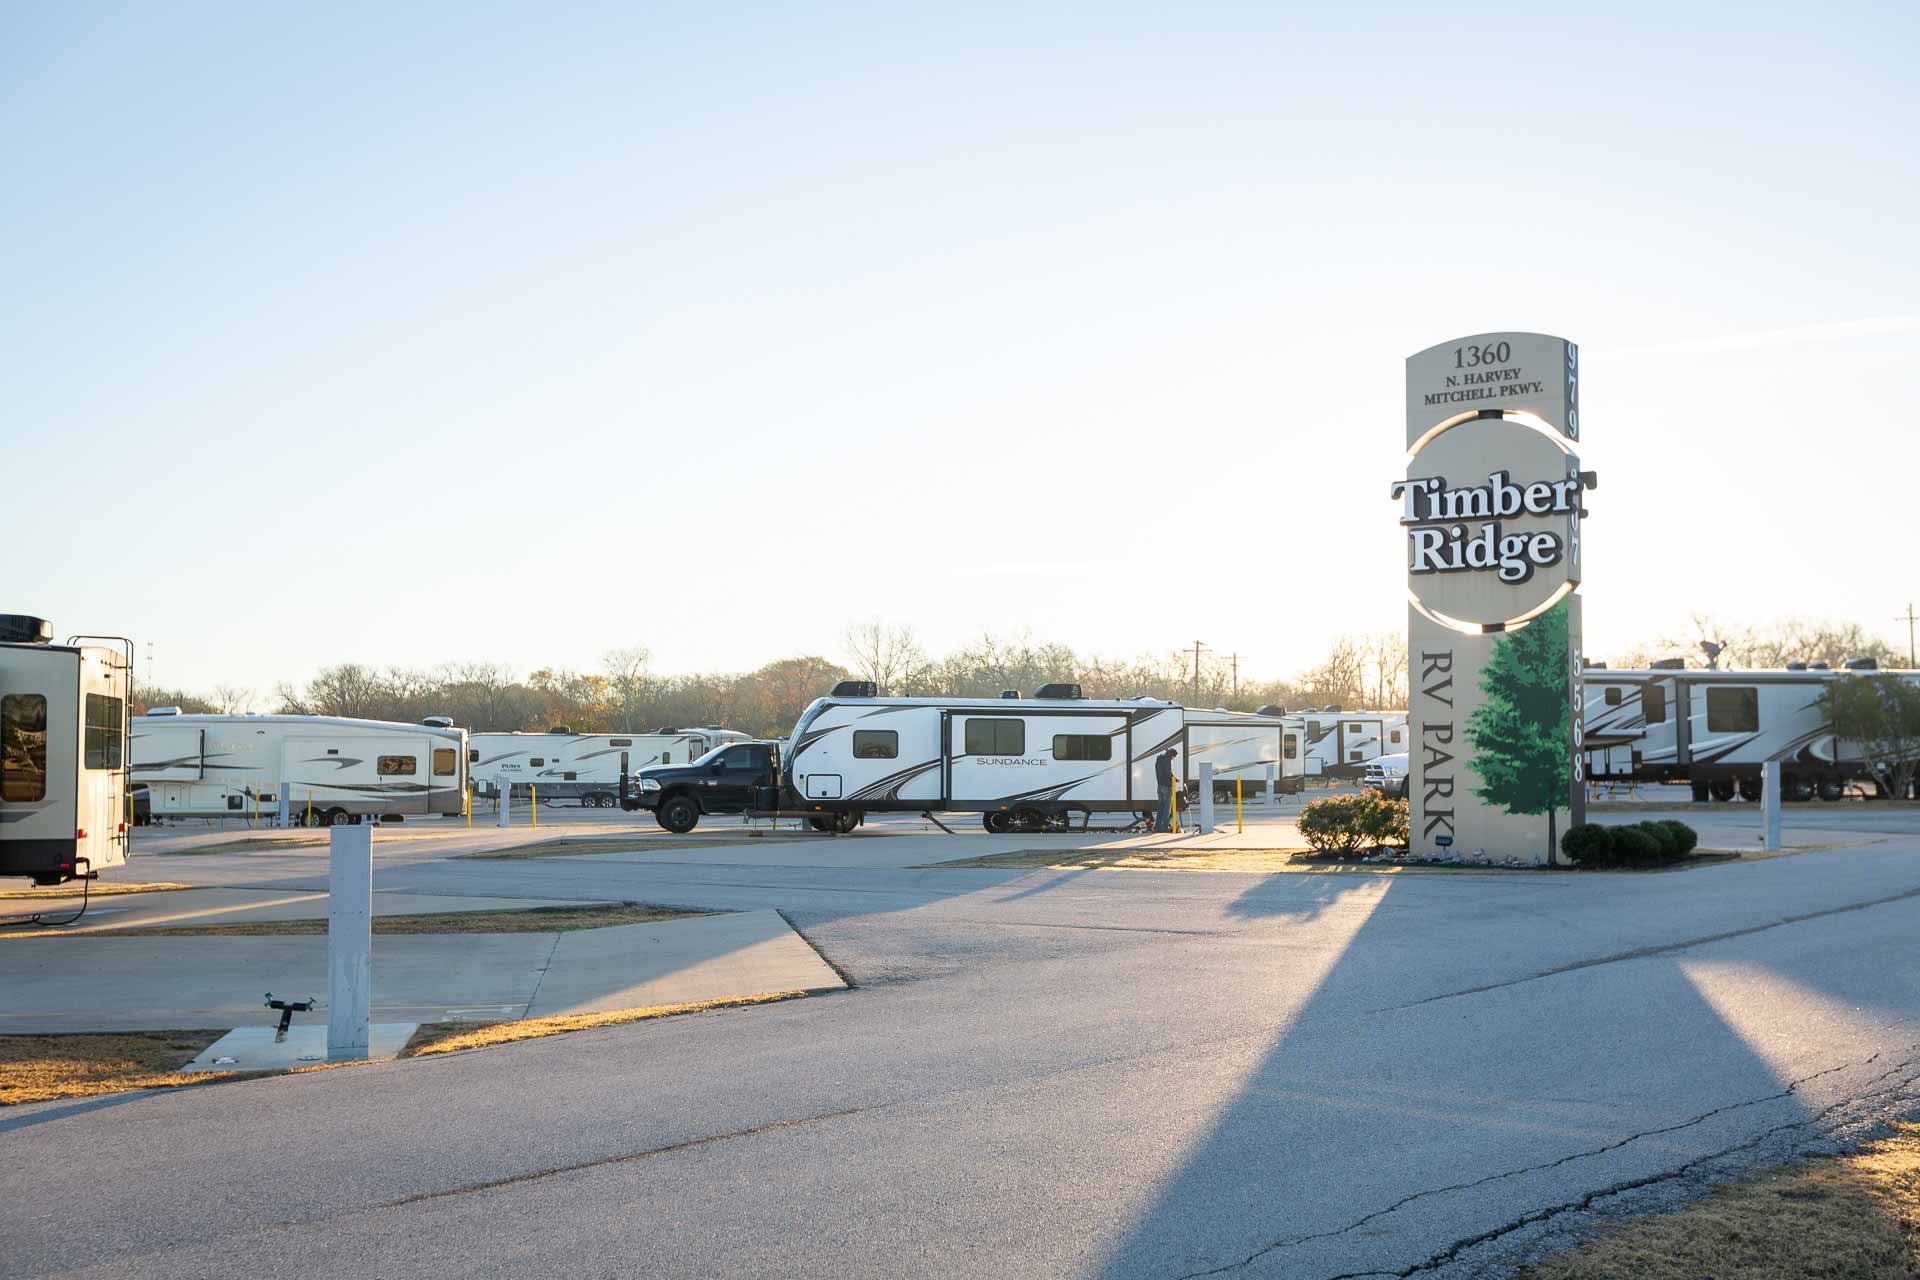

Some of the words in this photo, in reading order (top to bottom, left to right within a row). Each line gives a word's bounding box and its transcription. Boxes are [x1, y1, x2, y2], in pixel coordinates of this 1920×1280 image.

[1446, 375, 1460, 387] N.
[1464, 368, 1522, 385] HARVEY
[1454, 341, 1511, 369] 1360
[1424, 387, 1497, 405] MITCHELL
[1500, 381, 1544, 397] PKWY.
[1568, 342, 1577, 438] 979
[1391, 472, 1578, 522] Timber
[1410, 523, 1556, 580] Ridge
[1421, 649, 1453, 709] RV
[1572, 648, 1583, 783] 5568
[976, 757, 1048, 766] SUNDANCE
[1422, 721, 1455, 839] PARK
